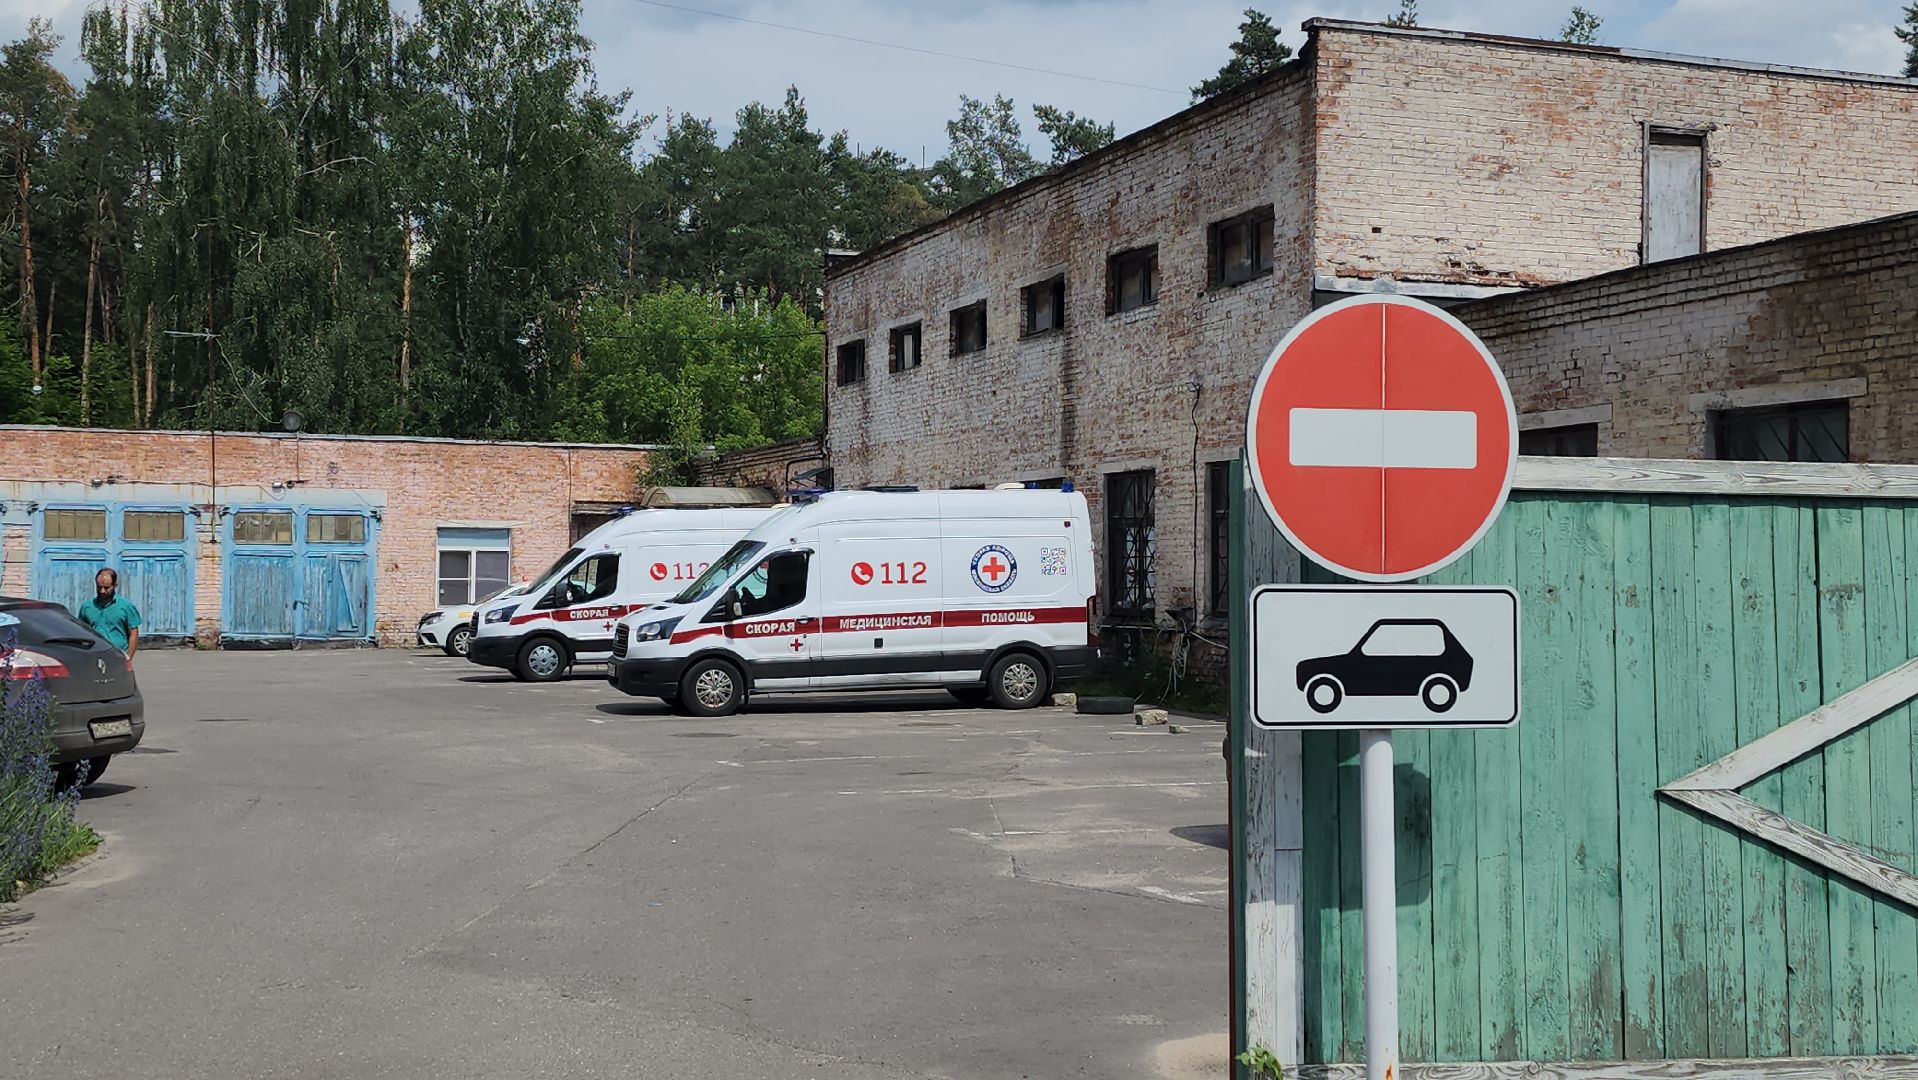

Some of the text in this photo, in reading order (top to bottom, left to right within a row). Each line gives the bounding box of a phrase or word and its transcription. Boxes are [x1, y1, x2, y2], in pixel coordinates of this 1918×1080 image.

[881, 562, 927, 584] 112
[569, 608, 609, 619] СКОРАЯ
[745, 610, 1035, 635] СКОРАЯ МЕДИЦИНСКАЯ ПОМОЩЬ
